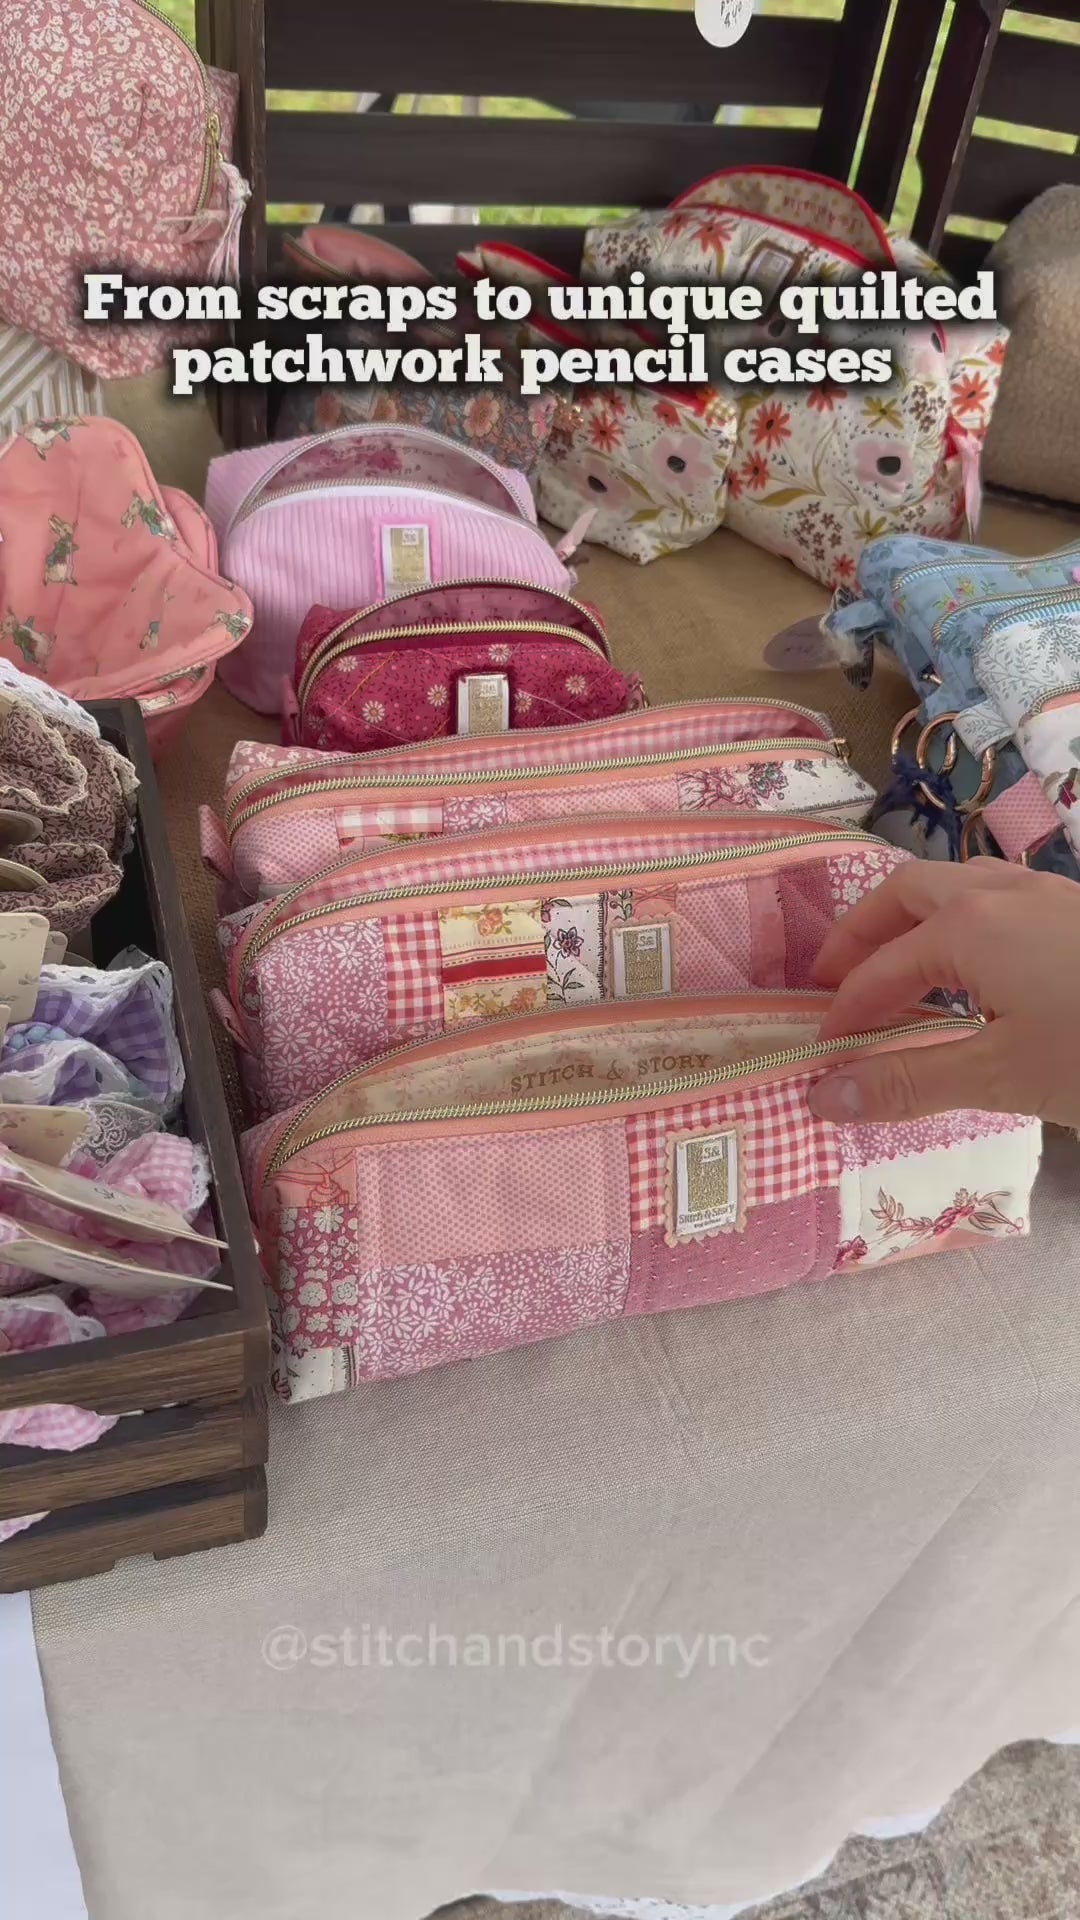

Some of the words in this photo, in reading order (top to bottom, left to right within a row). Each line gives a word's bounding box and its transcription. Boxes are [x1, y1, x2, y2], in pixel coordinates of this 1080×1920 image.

[511, 1064, 593, 1093] STITCH
[606, 1059, 623, 1080] &
[637, 1054, 711, 1076] STORY
